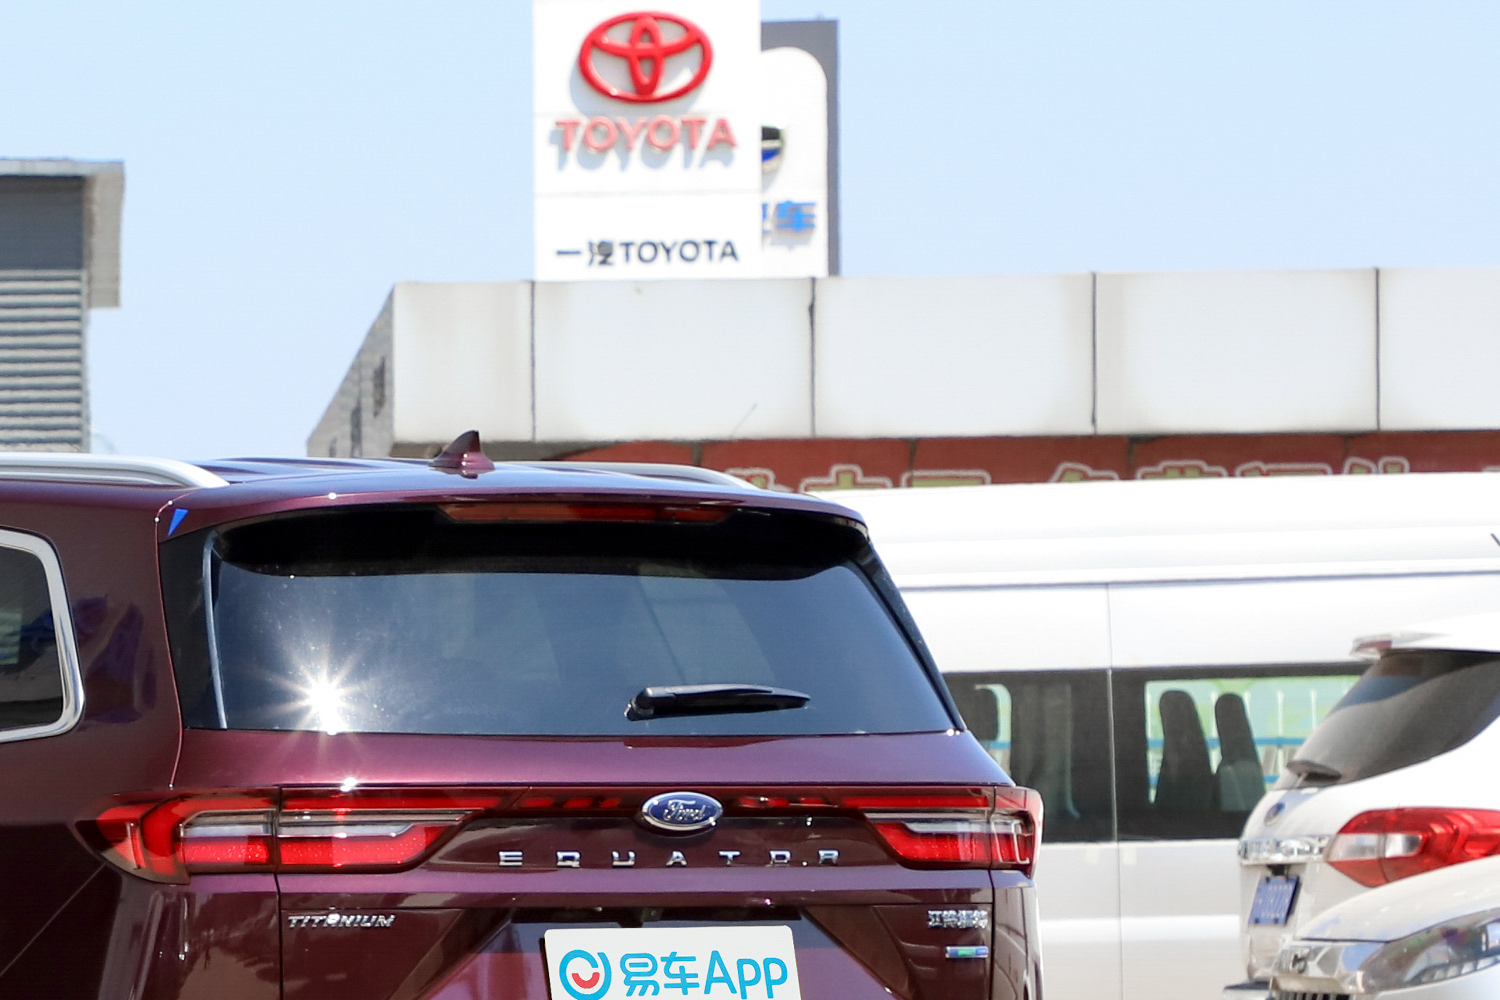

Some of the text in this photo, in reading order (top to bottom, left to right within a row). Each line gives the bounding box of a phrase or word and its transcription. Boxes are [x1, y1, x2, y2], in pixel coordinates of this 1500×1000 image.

[555, 115, 737, 151] TOYOTA
[499, 850, 840, 869] EQUATOR
[288, 913, 396, 928] TITANIUM
[619, 950, 788, 1000] 易车App
